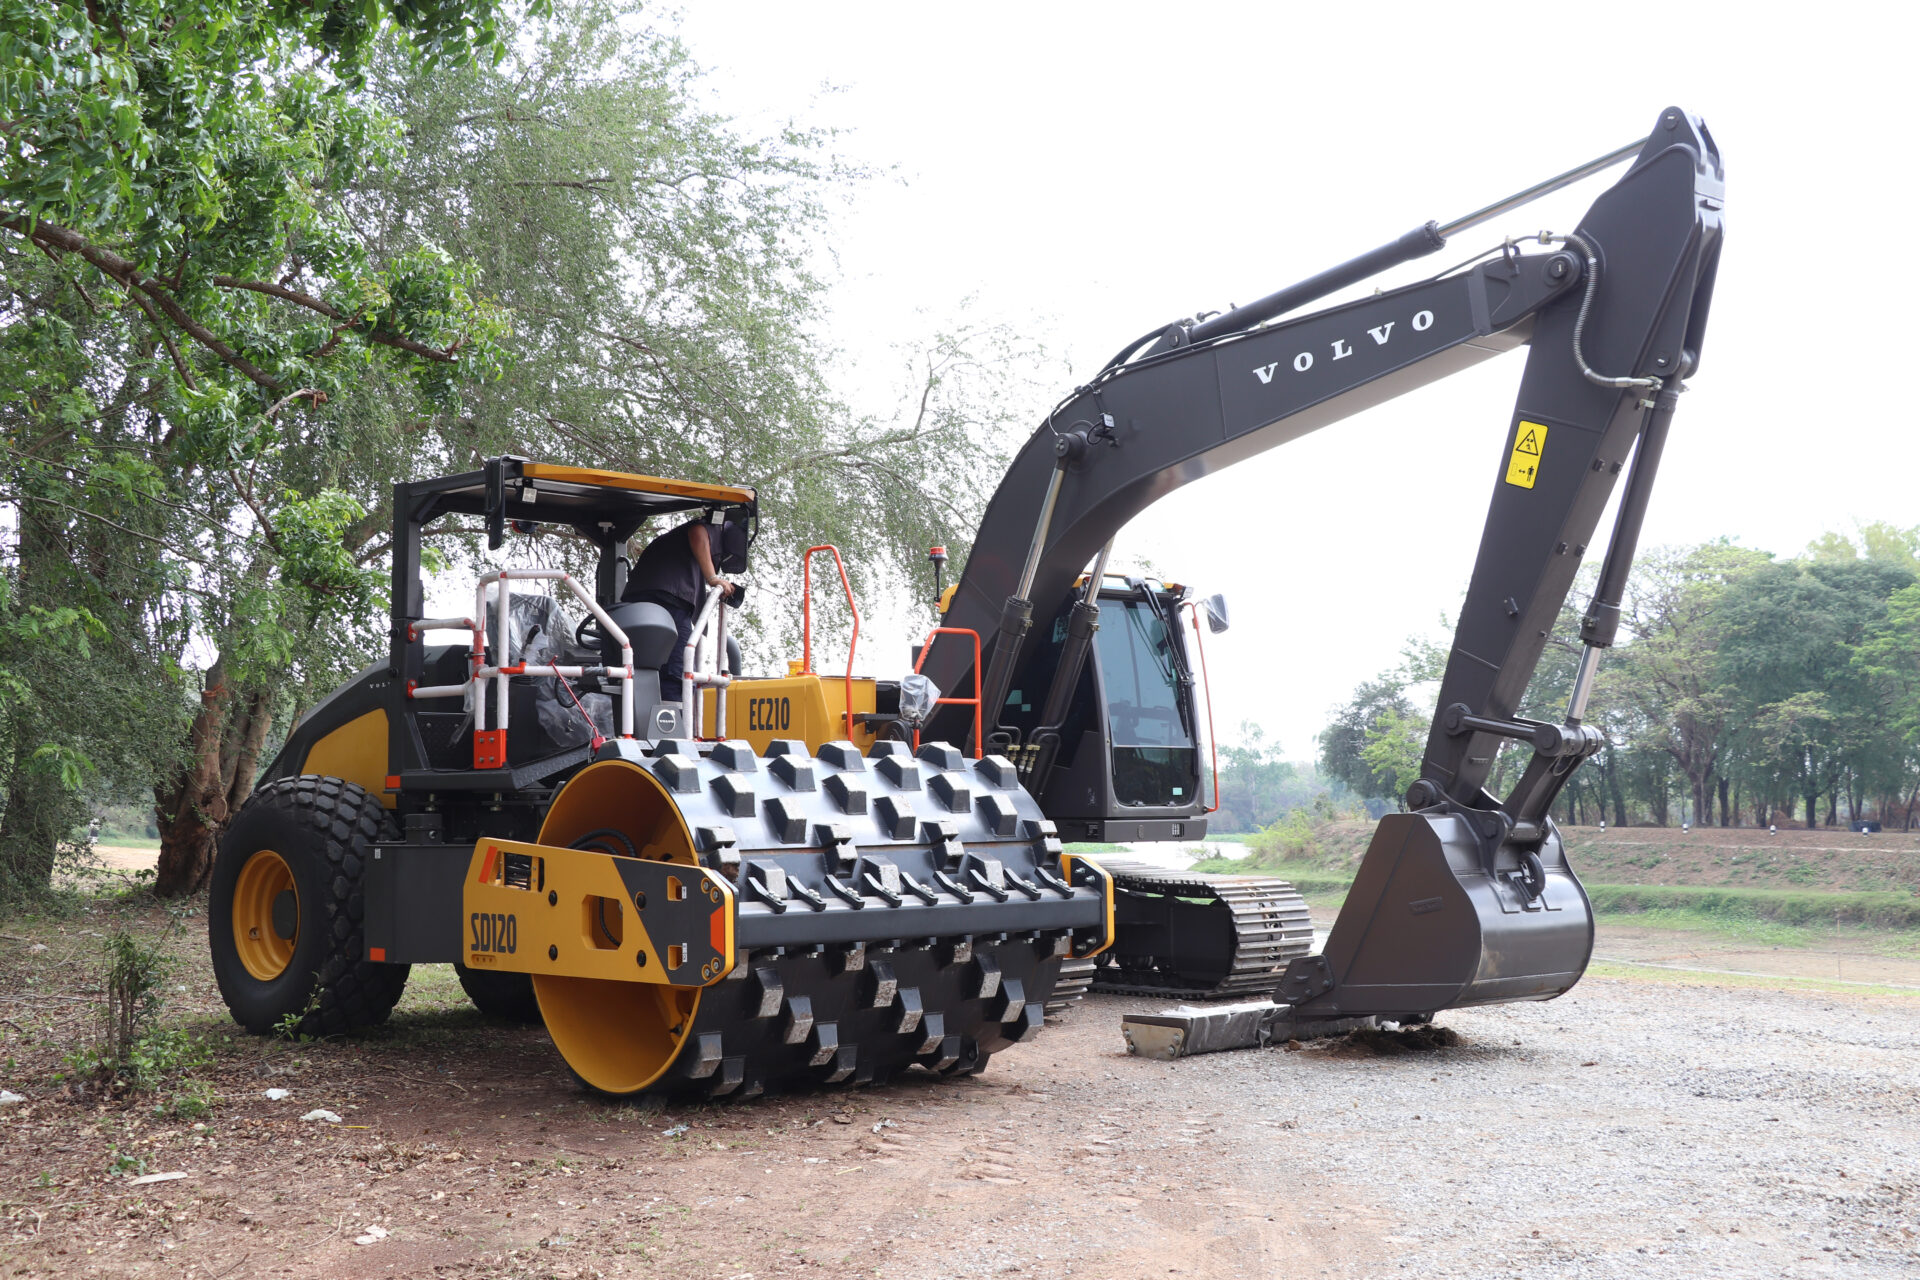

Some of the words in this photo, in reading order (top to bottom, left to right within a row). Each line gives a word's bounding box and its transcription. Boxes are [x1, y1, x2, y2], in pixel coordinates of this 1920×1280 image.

[1253, 310, 1434, 384] VOLVO
[749, 697, 790, 731] EC210
[471, 912, 517, 954] SD120
